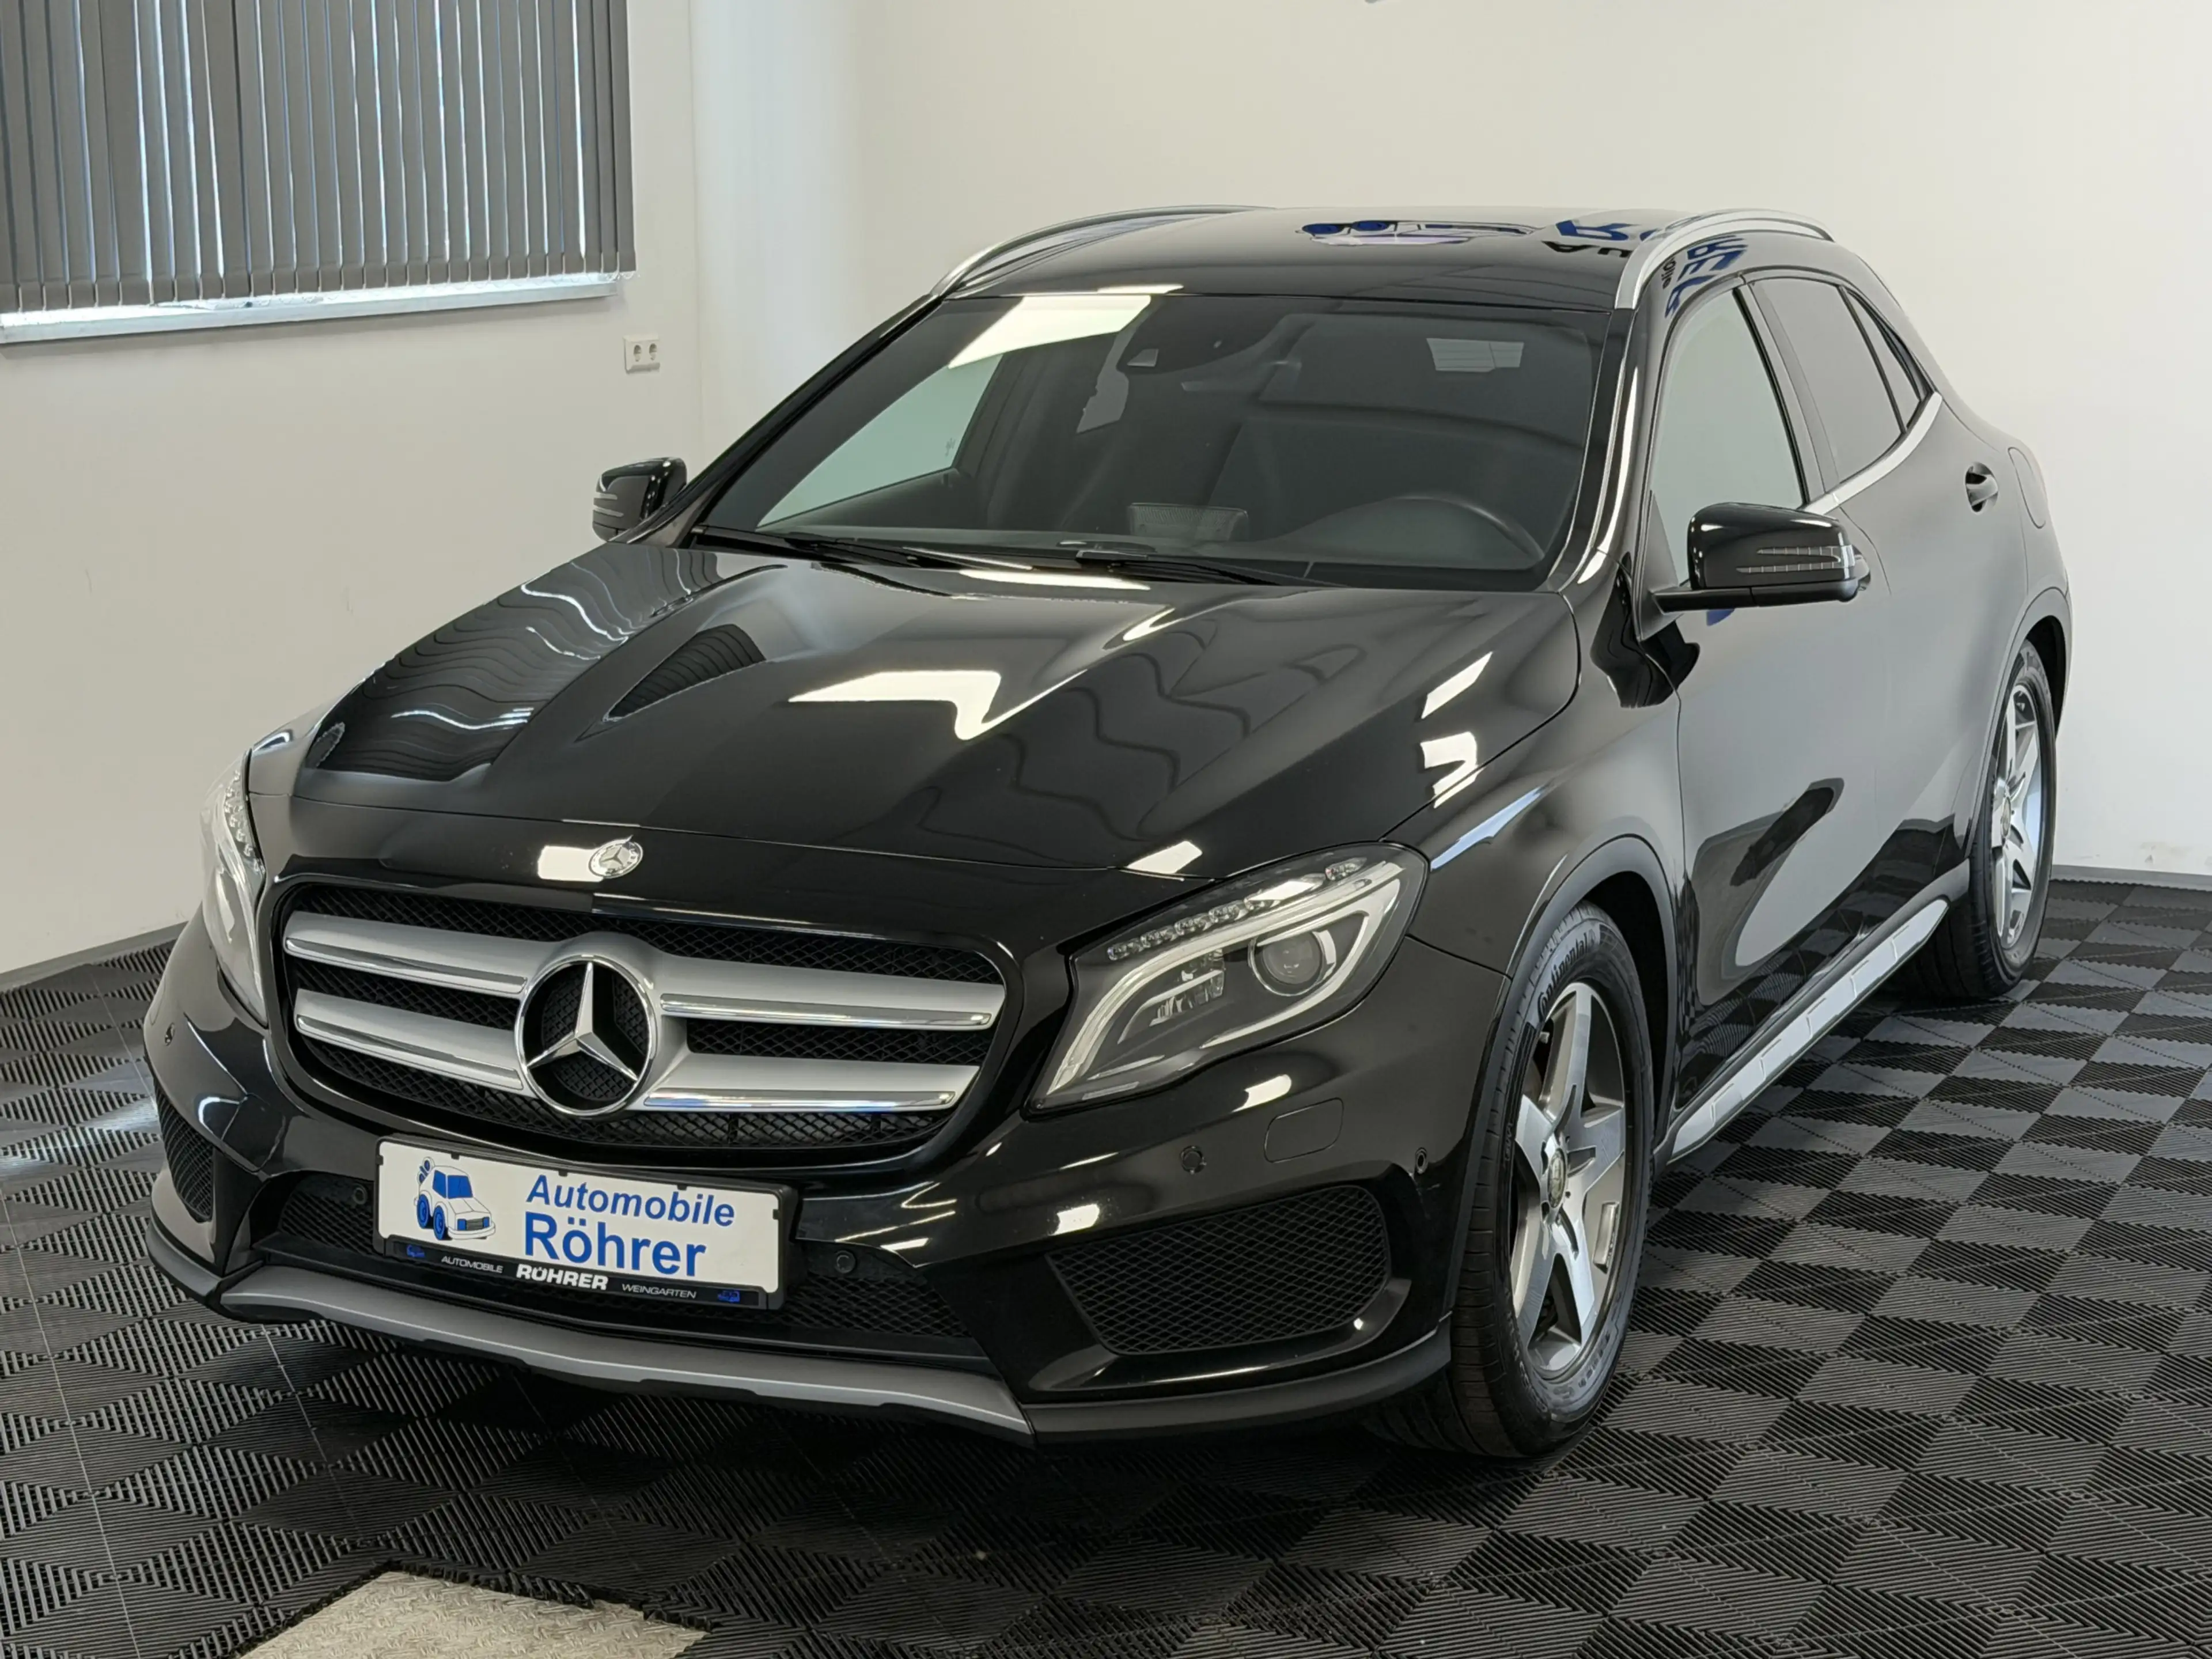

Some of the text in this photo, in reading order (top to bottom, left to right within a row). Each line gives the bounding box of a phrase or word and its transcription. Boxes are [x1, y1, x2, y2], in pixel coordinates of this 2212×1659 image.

[527, 1175, 734, 1226] Automobile
[525, 1211, 706, 1278] Röhrer
[441, 1255, 697, 1300] AUTOMOBILE RÖHRER WEINGARTEN
